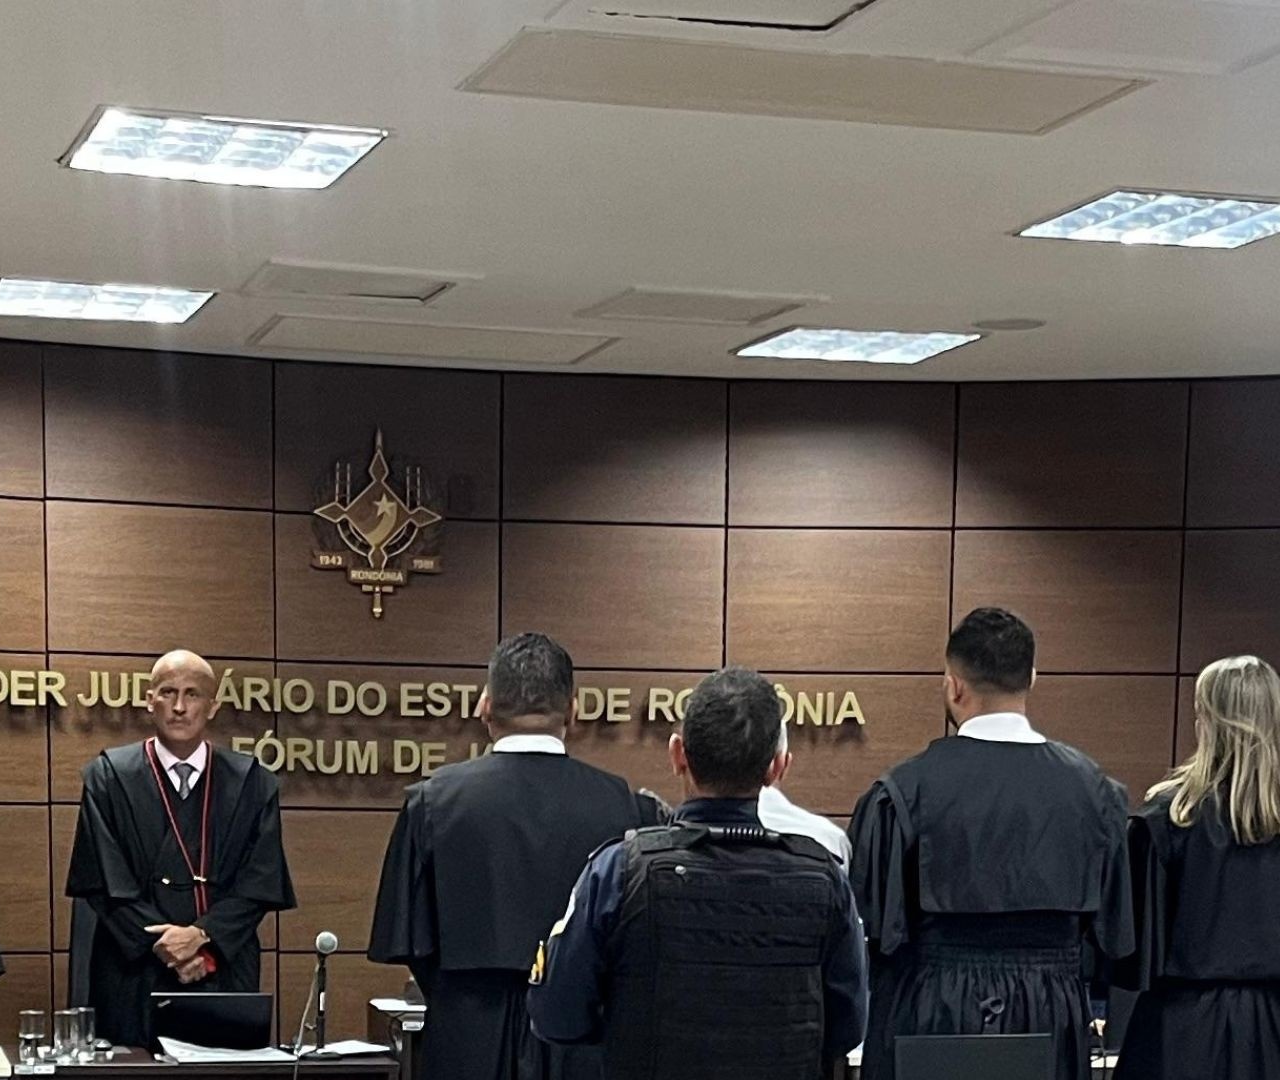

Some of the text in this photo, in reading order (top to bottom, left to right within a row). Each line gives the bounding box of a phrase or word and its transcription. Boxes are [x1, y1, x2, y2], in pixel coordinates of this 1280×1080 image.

[76, 667, 315, 714] JUDÁRIO
[326, 679, 387, 717] DO
[576, 686, 632, 722] DE
[231, 729, 448, 778] FÓRUM DE
